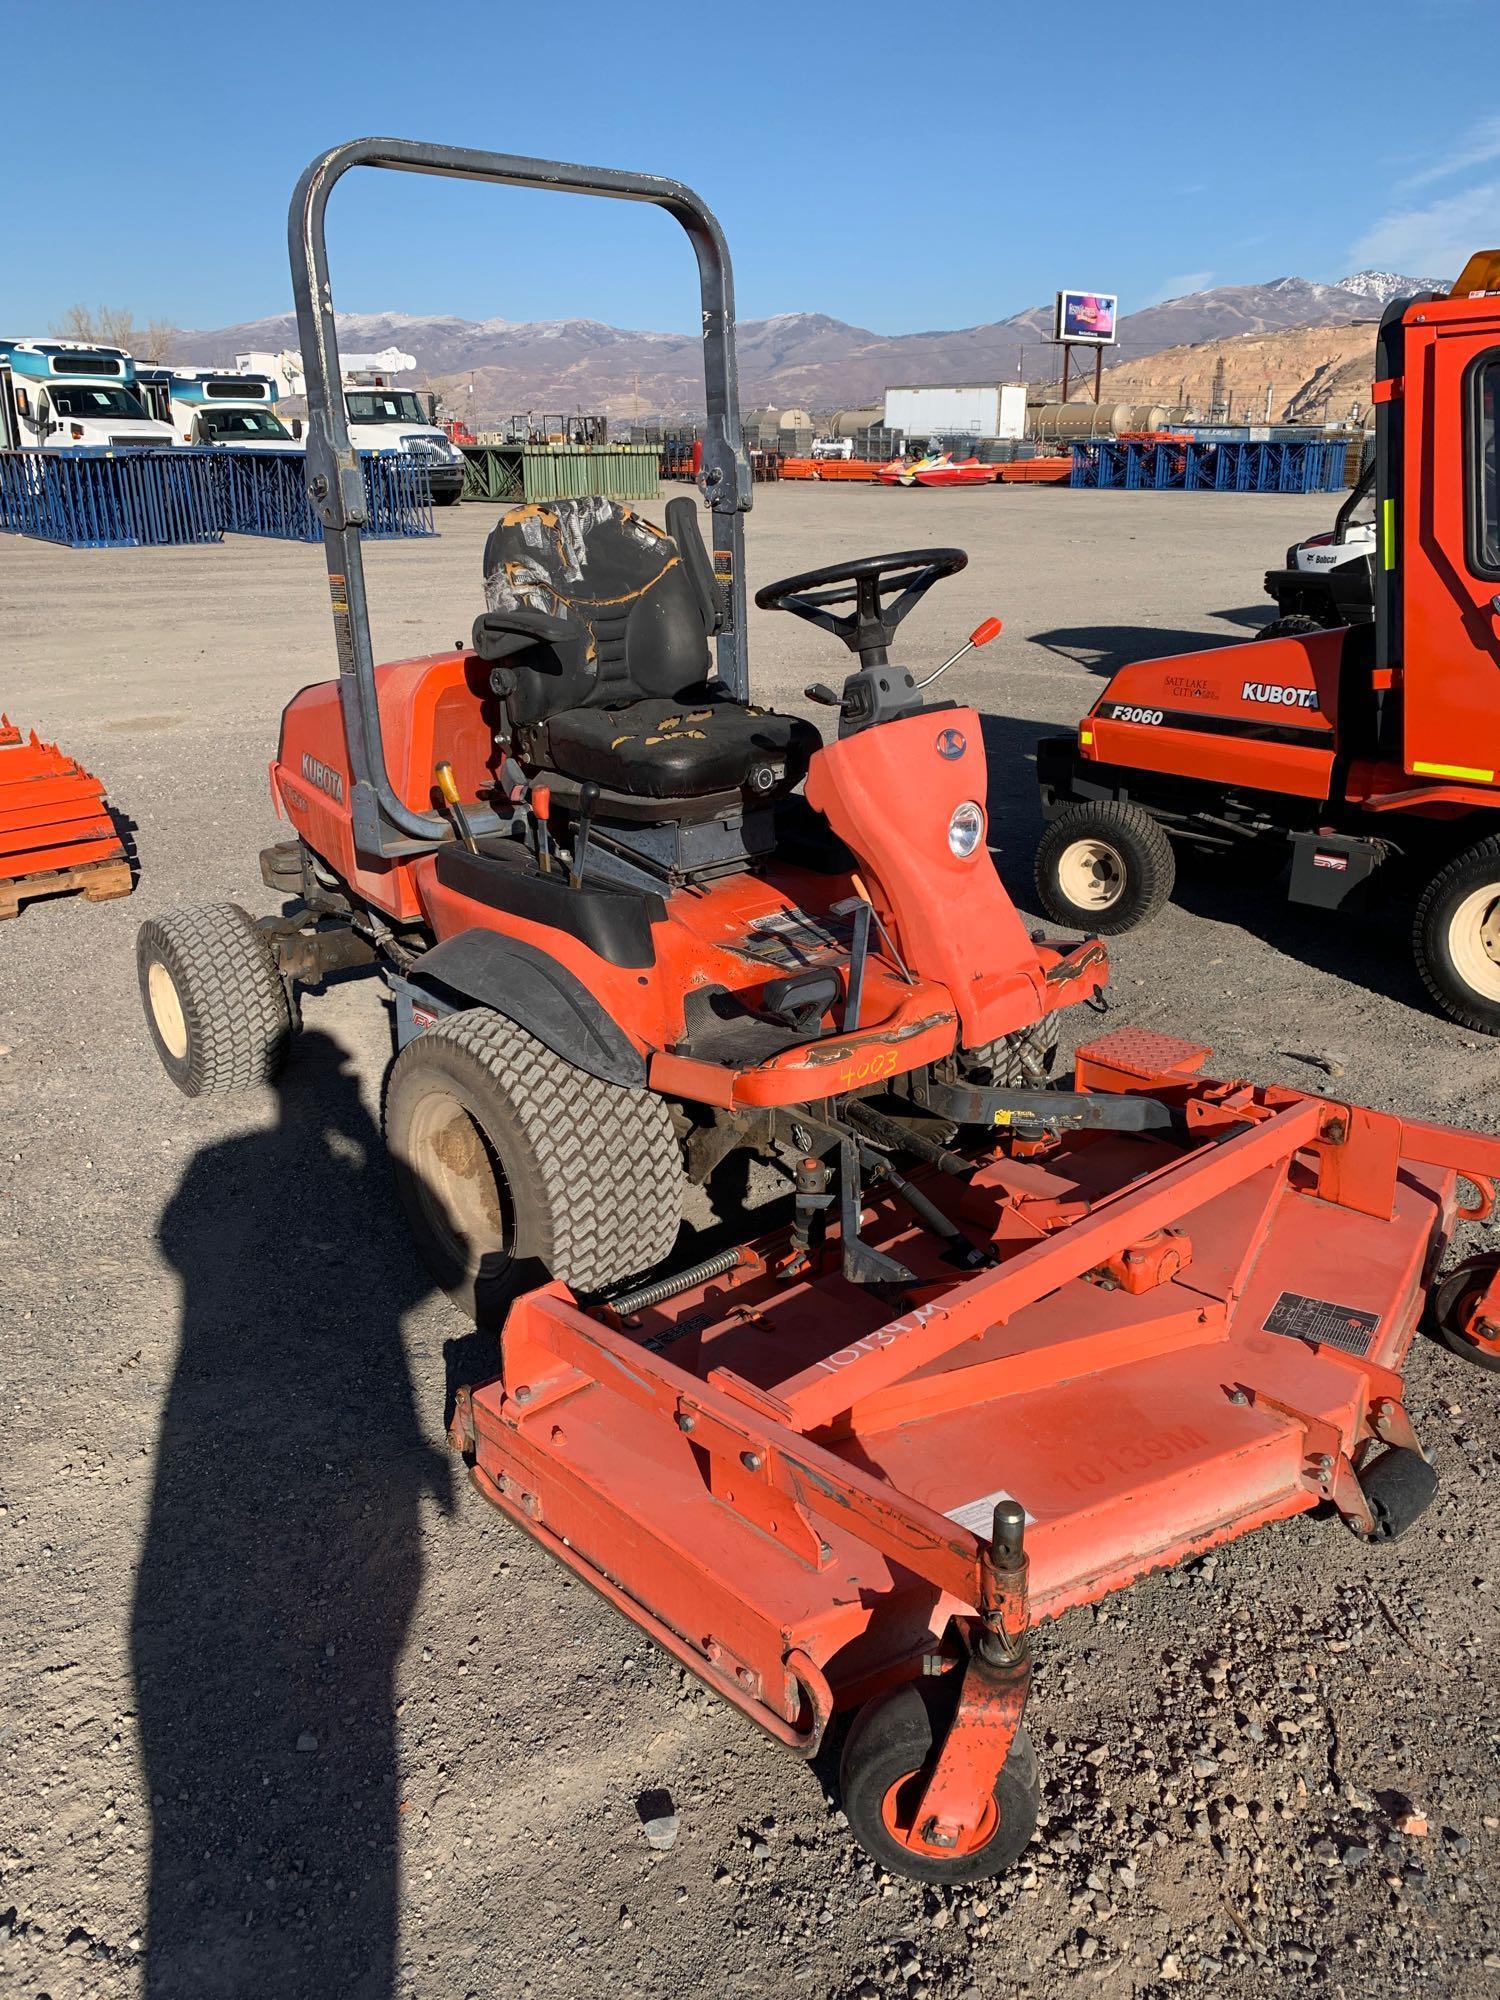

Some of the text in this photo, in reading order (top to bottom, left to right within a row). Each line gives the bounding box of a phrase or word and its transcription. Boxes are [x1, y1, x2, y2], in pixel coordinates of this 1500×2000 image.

[1315, 555, 1337, 564] Bobcat
[1165, 676, 1208, 690] SALT LAKE
[1173, 687, 1195, 697] CITY
[1241, 682, 1320, 709] KUBOTA
[1111, 705, 1164, 726] F3060
[302, 751, 344, 805] KUBOTA
[840, 1050, 898, 1088] 4003
